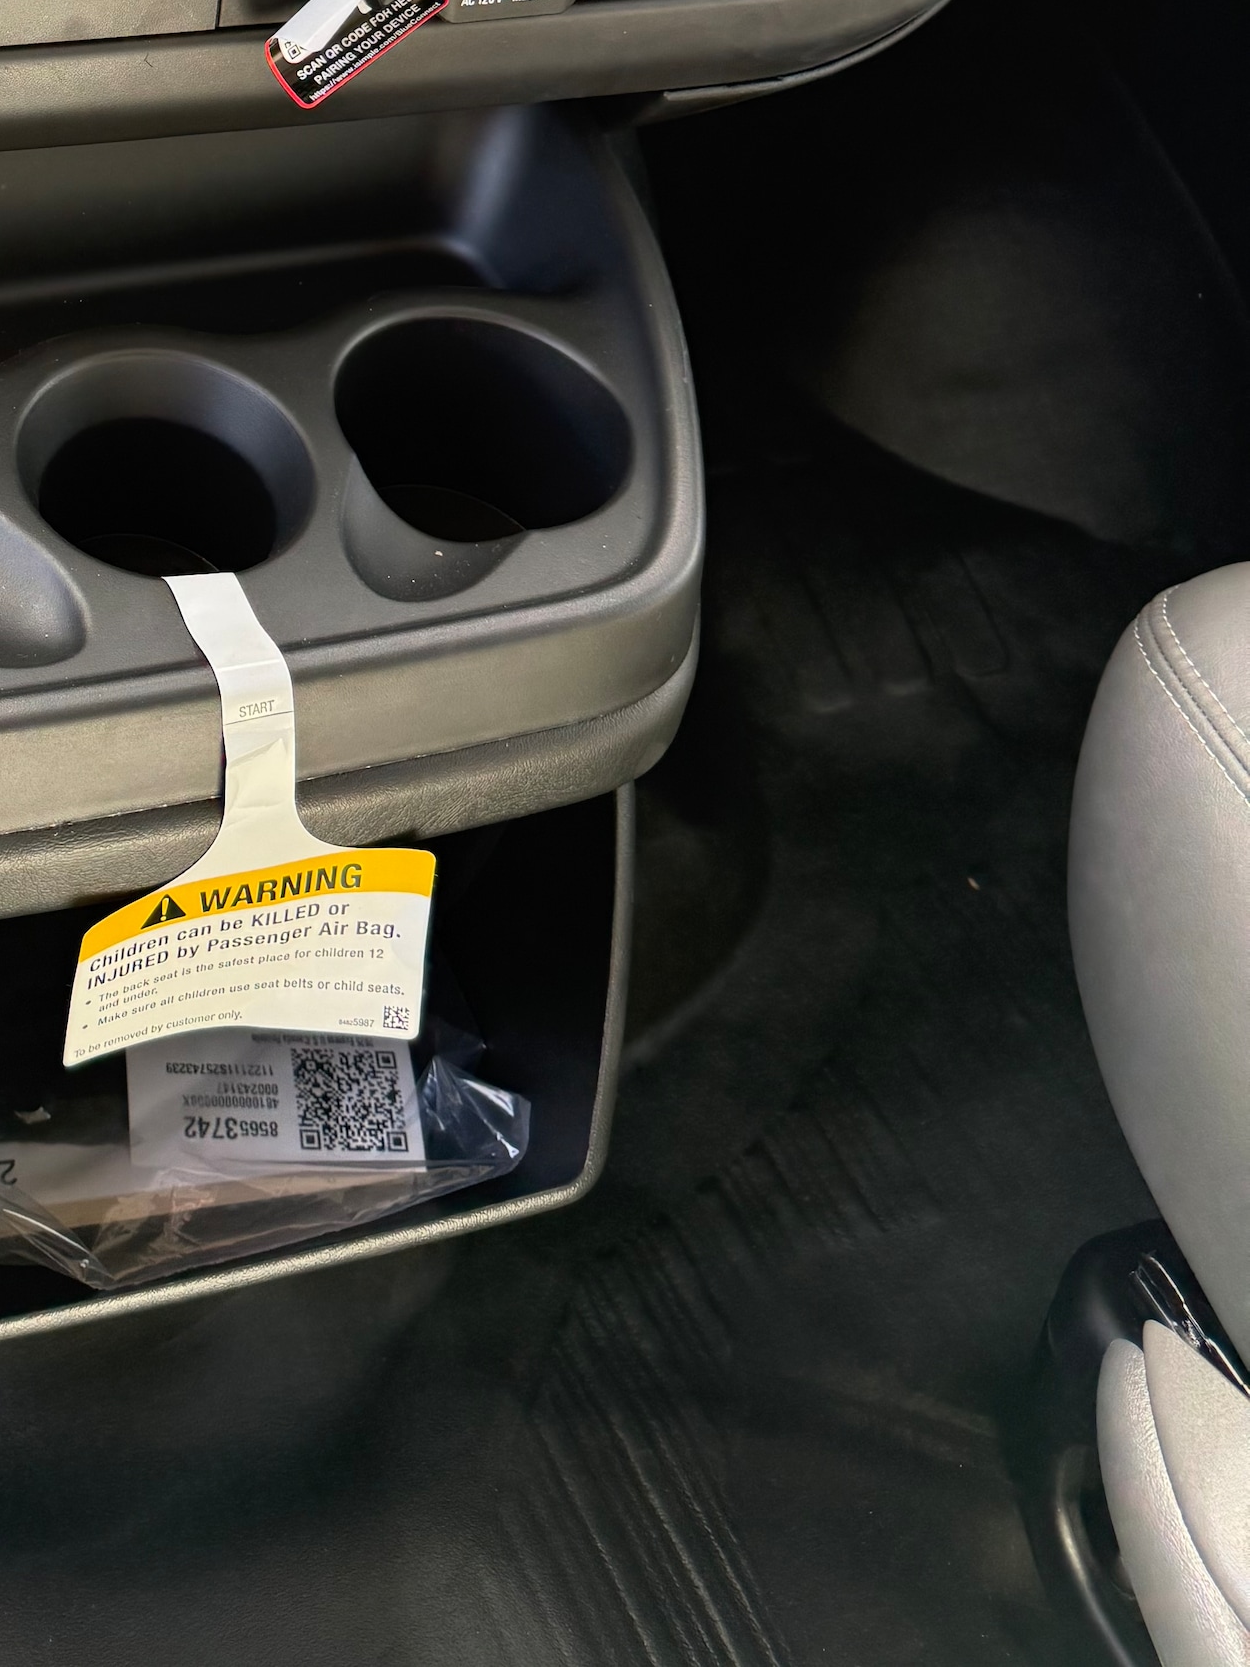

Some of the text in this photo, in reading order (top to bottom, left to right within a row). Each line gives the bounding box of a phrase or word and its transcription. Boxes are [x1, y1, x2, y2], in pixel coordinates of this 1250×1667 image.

[296, 55, 329, 81] SCAN
[325, 44, 344, 61] QR
[341, 23, 373, 48] CODE
[370, 8, 395, 28] FOR
[313, 3, 422, 86] PAIRING YOUR DEVICE
[239, 699, 275, 718] START
[200, 863, 363, 913] WARNING
[87, 920, 402, 990] INJURED by Passenger Air Bag.
[89, 903, 350, 973] Children can be KILLED or
[98, 987, 159, 1013] and under.
[99, 947, 384, 1003] The back seat is the safest place for children 12
[97, 978, 405, 1027] Make sure all children use seat belts or child seats.
[74, 1009, 243, 1059] To be removed by customer only.
[184, 1116, 279, 1139] 85653742
